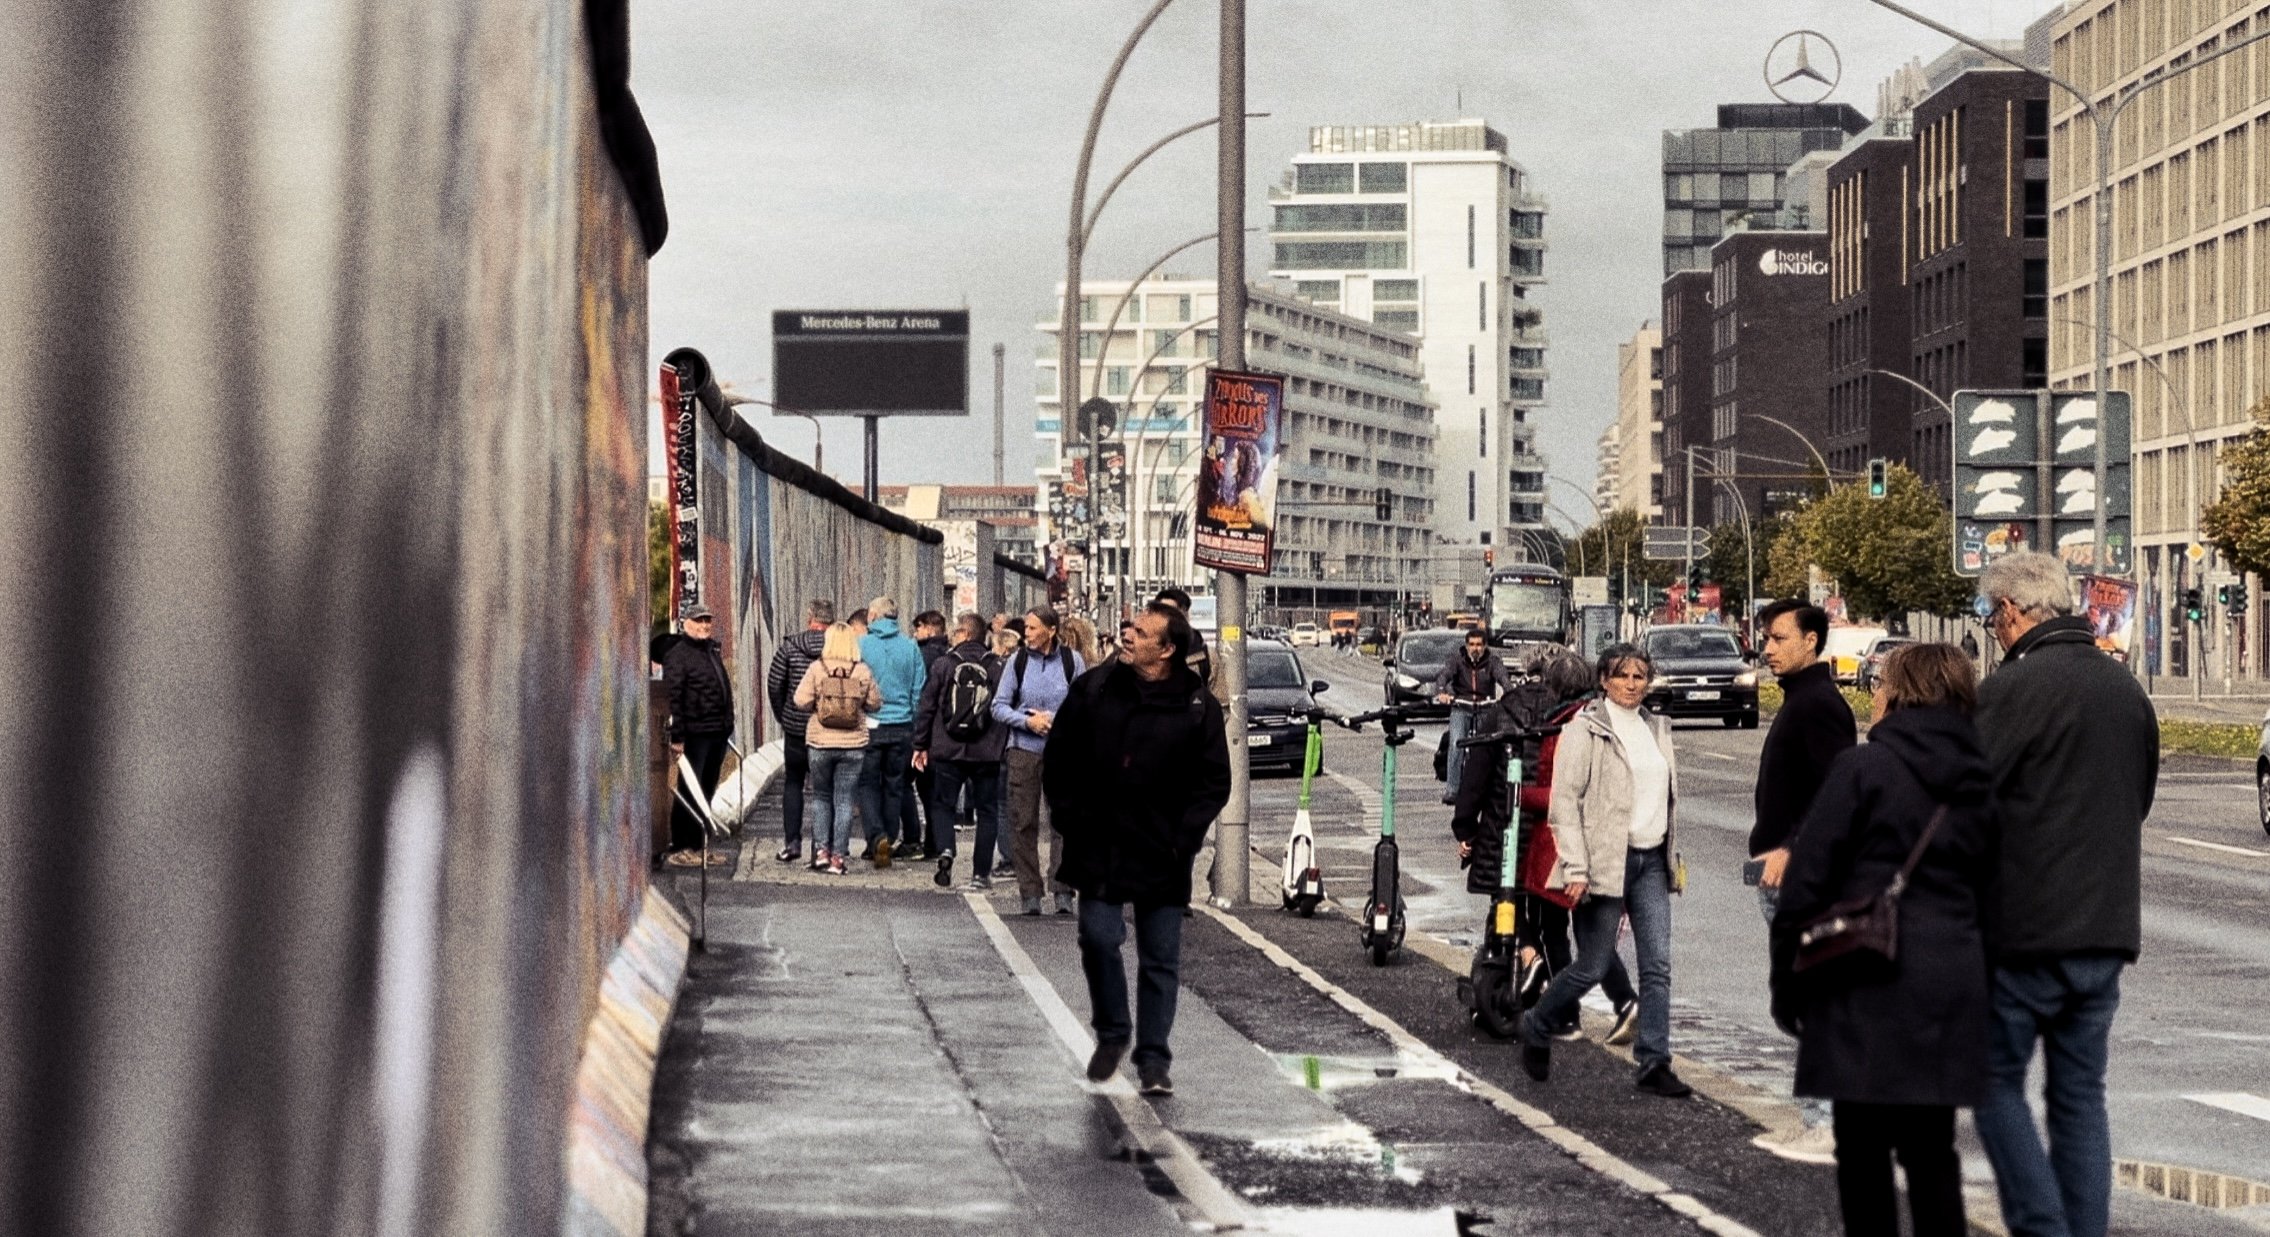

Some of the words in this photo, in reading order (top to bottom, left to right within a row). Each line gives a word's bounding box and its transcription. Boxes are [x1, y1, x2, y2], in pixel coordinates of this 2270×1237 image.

[1778, 249, 1813, 262] hotel
[800, 315, 897, 329] Mercedes-Benz
[900, 315, 940, 329] Arena
